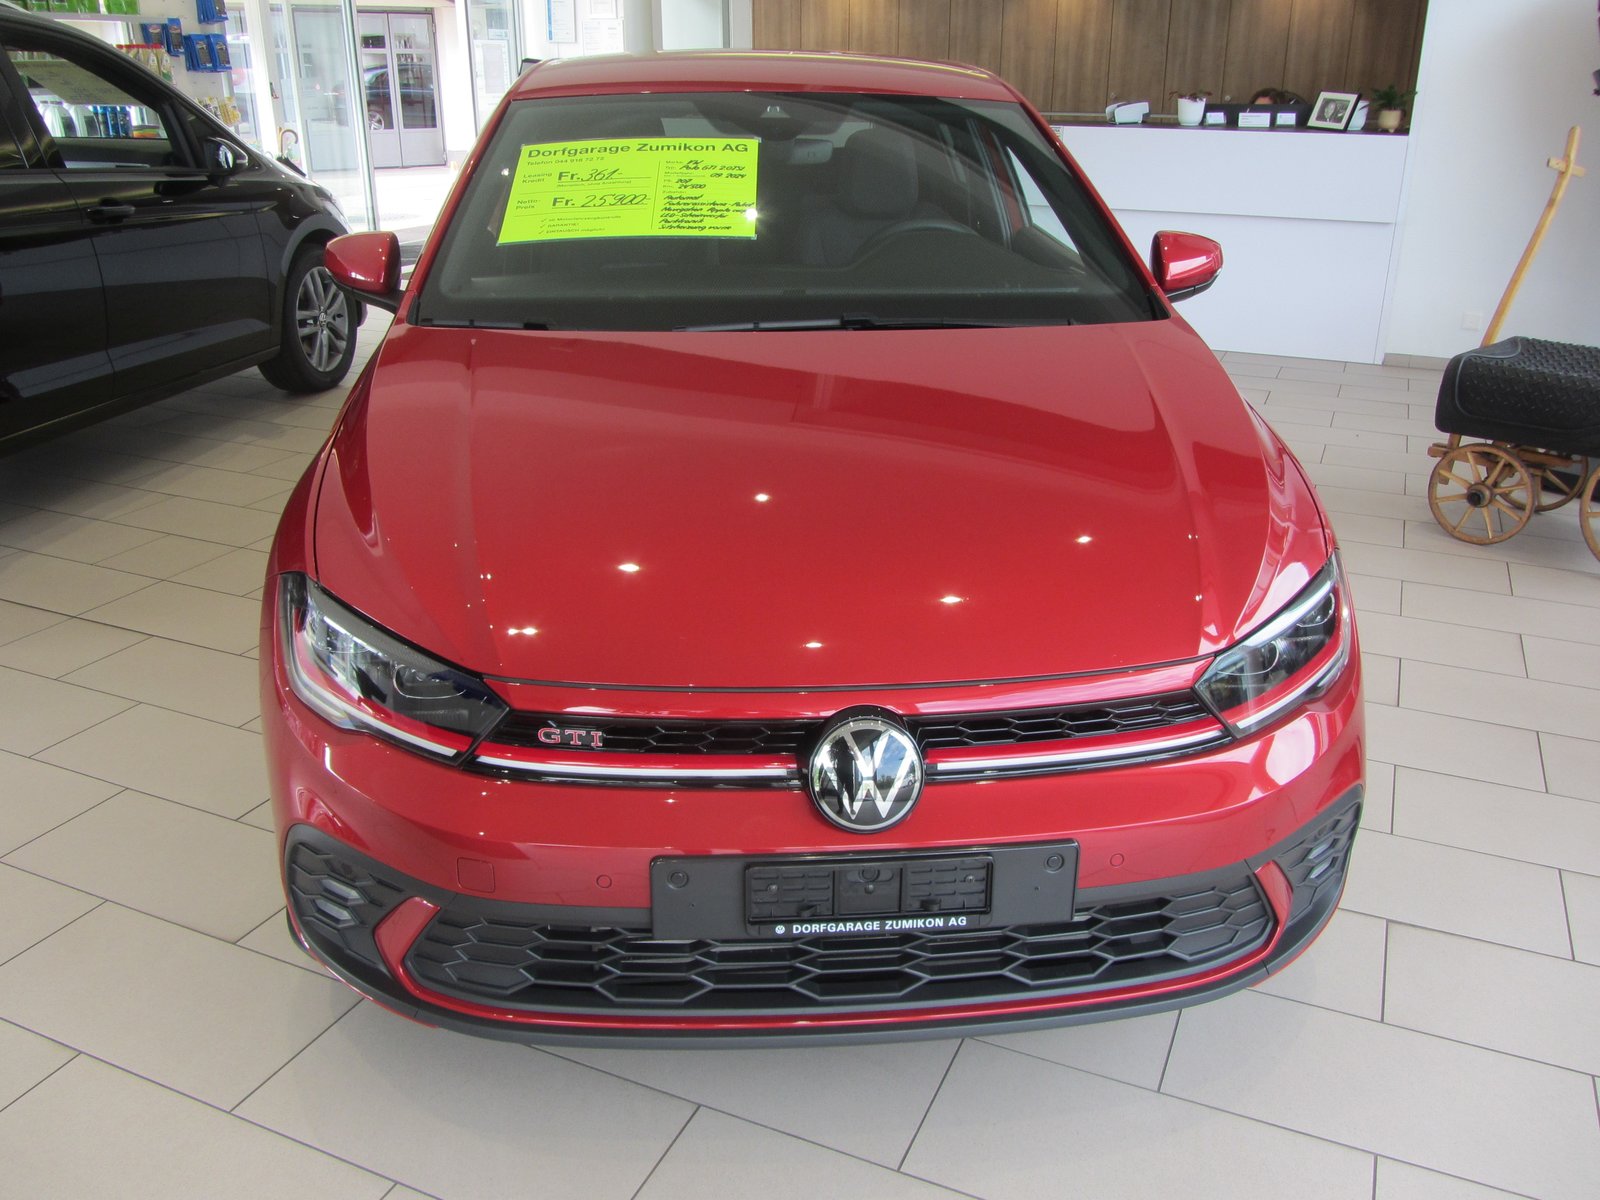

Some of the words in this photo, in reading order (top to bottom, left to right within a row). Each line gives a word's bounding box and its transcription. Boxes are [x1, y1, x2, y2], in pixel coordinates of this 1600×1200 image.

[527, 144, 631, 159] Dorfgarage
[636, 142, 717, 153] Zumikon
[722, 143, 749, 153] AG
[522, 171, 553, 179] Leasing
[557, 171, 581, 181] Fr.
[551, 196, 576, 207] Fr.
[537, 727, 603, 748] GTI
[792, 921, 881, 934] DORFGARAGE
[885, 917, 944, 930] ZUMIKON
[948, 916, 967, 926] AG
